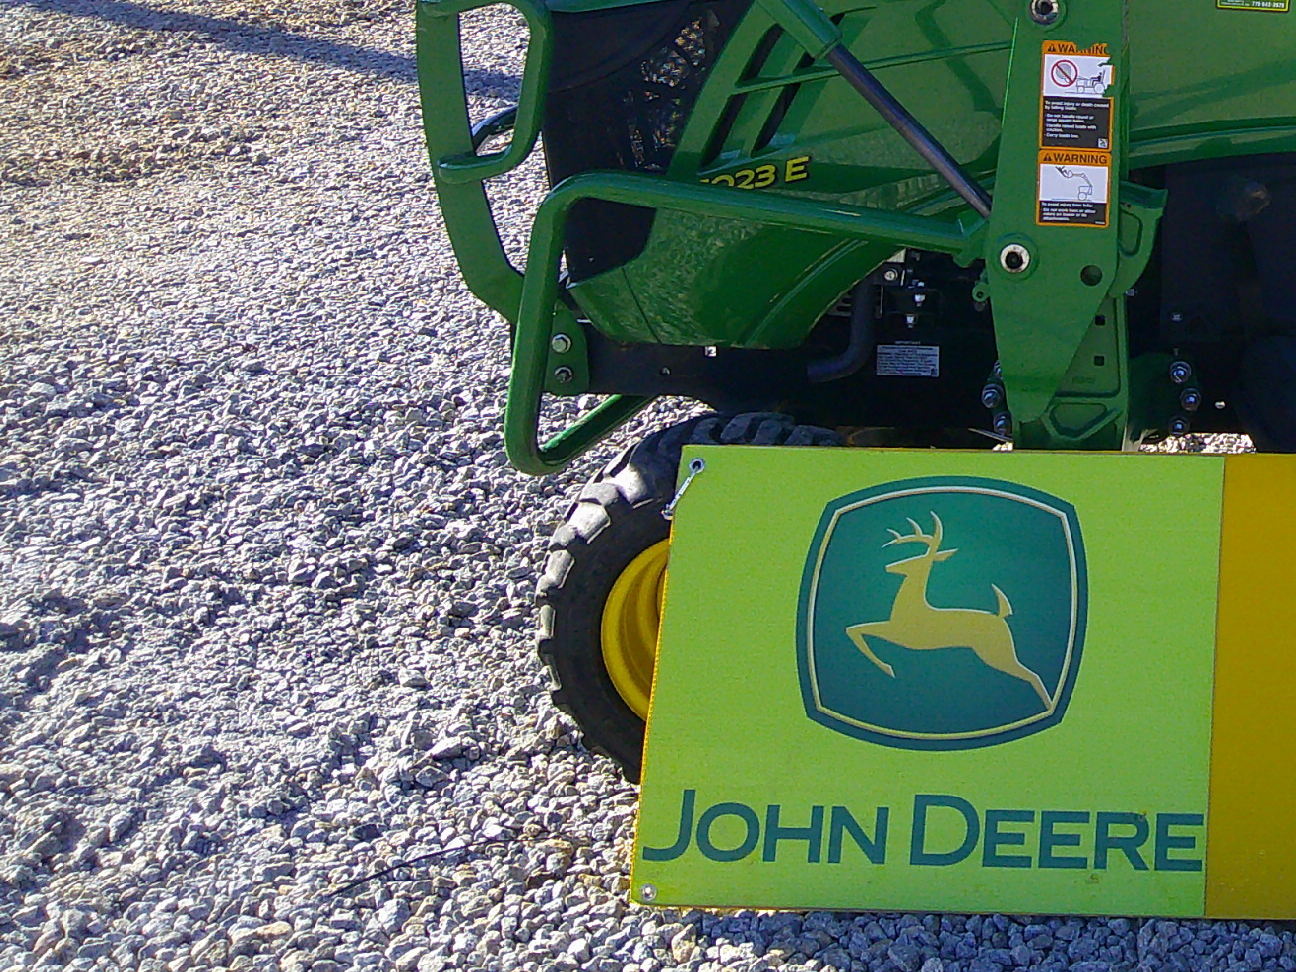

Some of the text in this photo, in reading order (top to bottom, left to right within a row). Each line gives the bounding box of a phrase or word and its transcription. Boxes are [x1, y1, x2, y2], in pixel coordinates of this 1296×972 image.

[1057, 43, 1107, 55] WAIN
[1054, 152, 1107, 165] WARNING
[700, 155, 810, 189] 023 E
[643, 789, 1204, 872] JOHN DEERE
